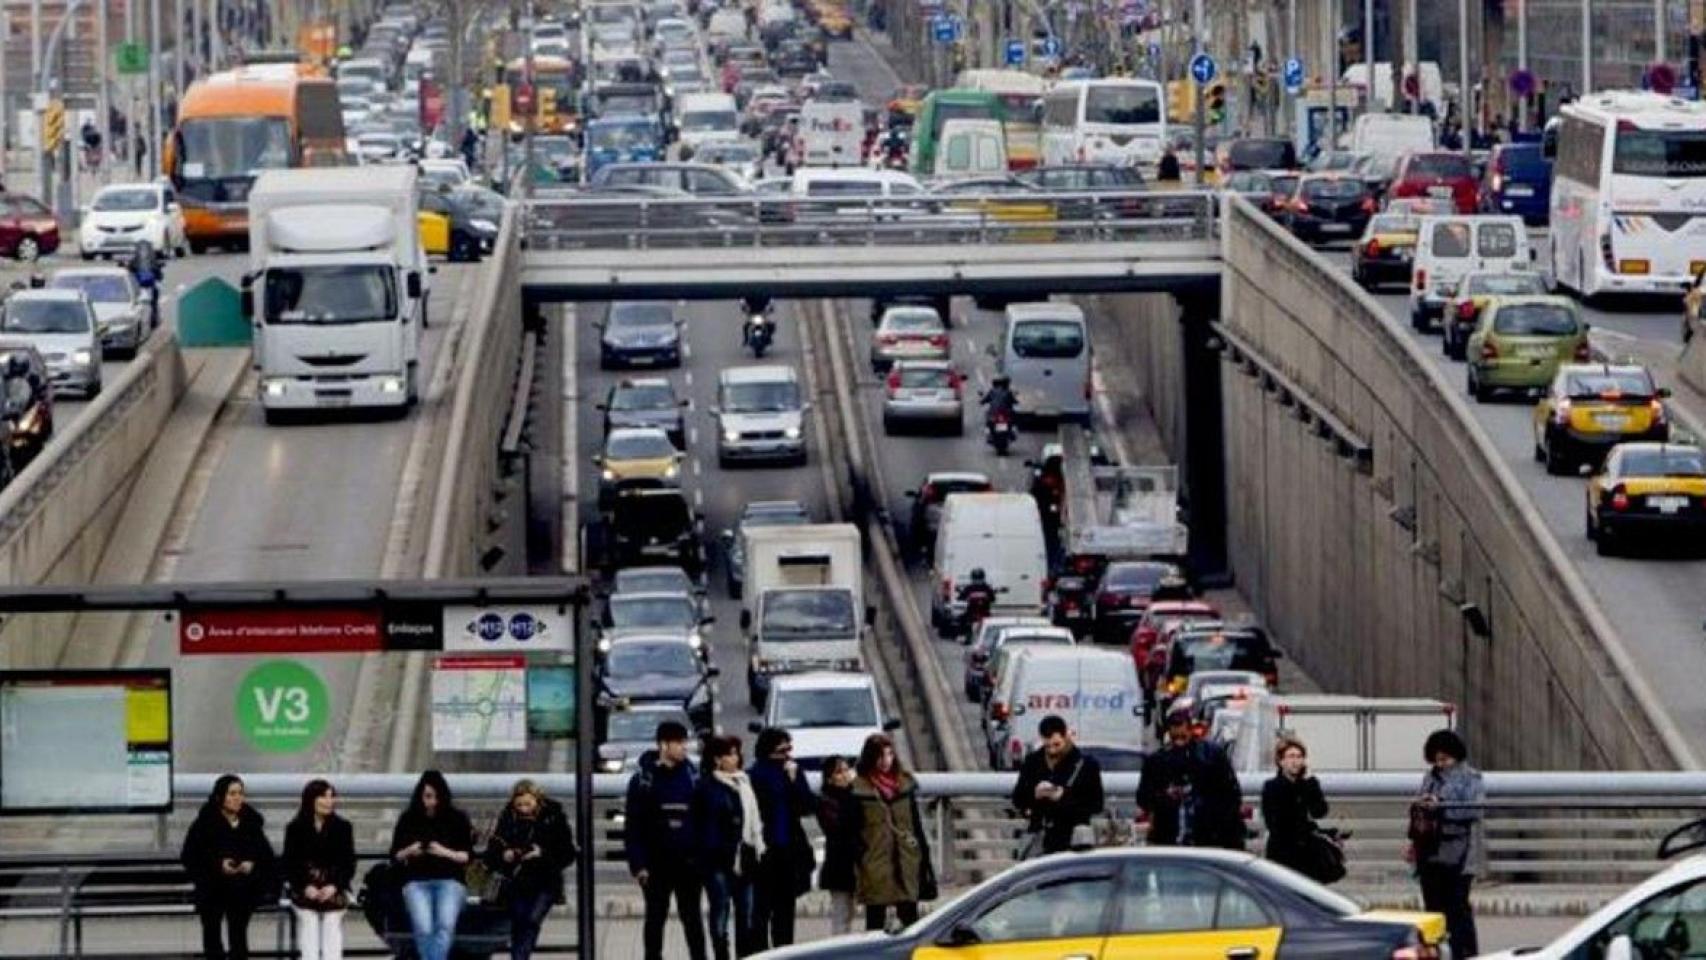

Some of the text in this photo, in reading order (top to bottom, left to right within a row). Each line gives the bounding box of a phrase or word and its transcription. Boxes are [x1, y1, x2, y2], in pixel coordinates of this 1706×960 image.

[811, 118, 853, 132] FedEx
[253, 687, 309, 722] V3
[1027, 689, 1124, 709] arafred
